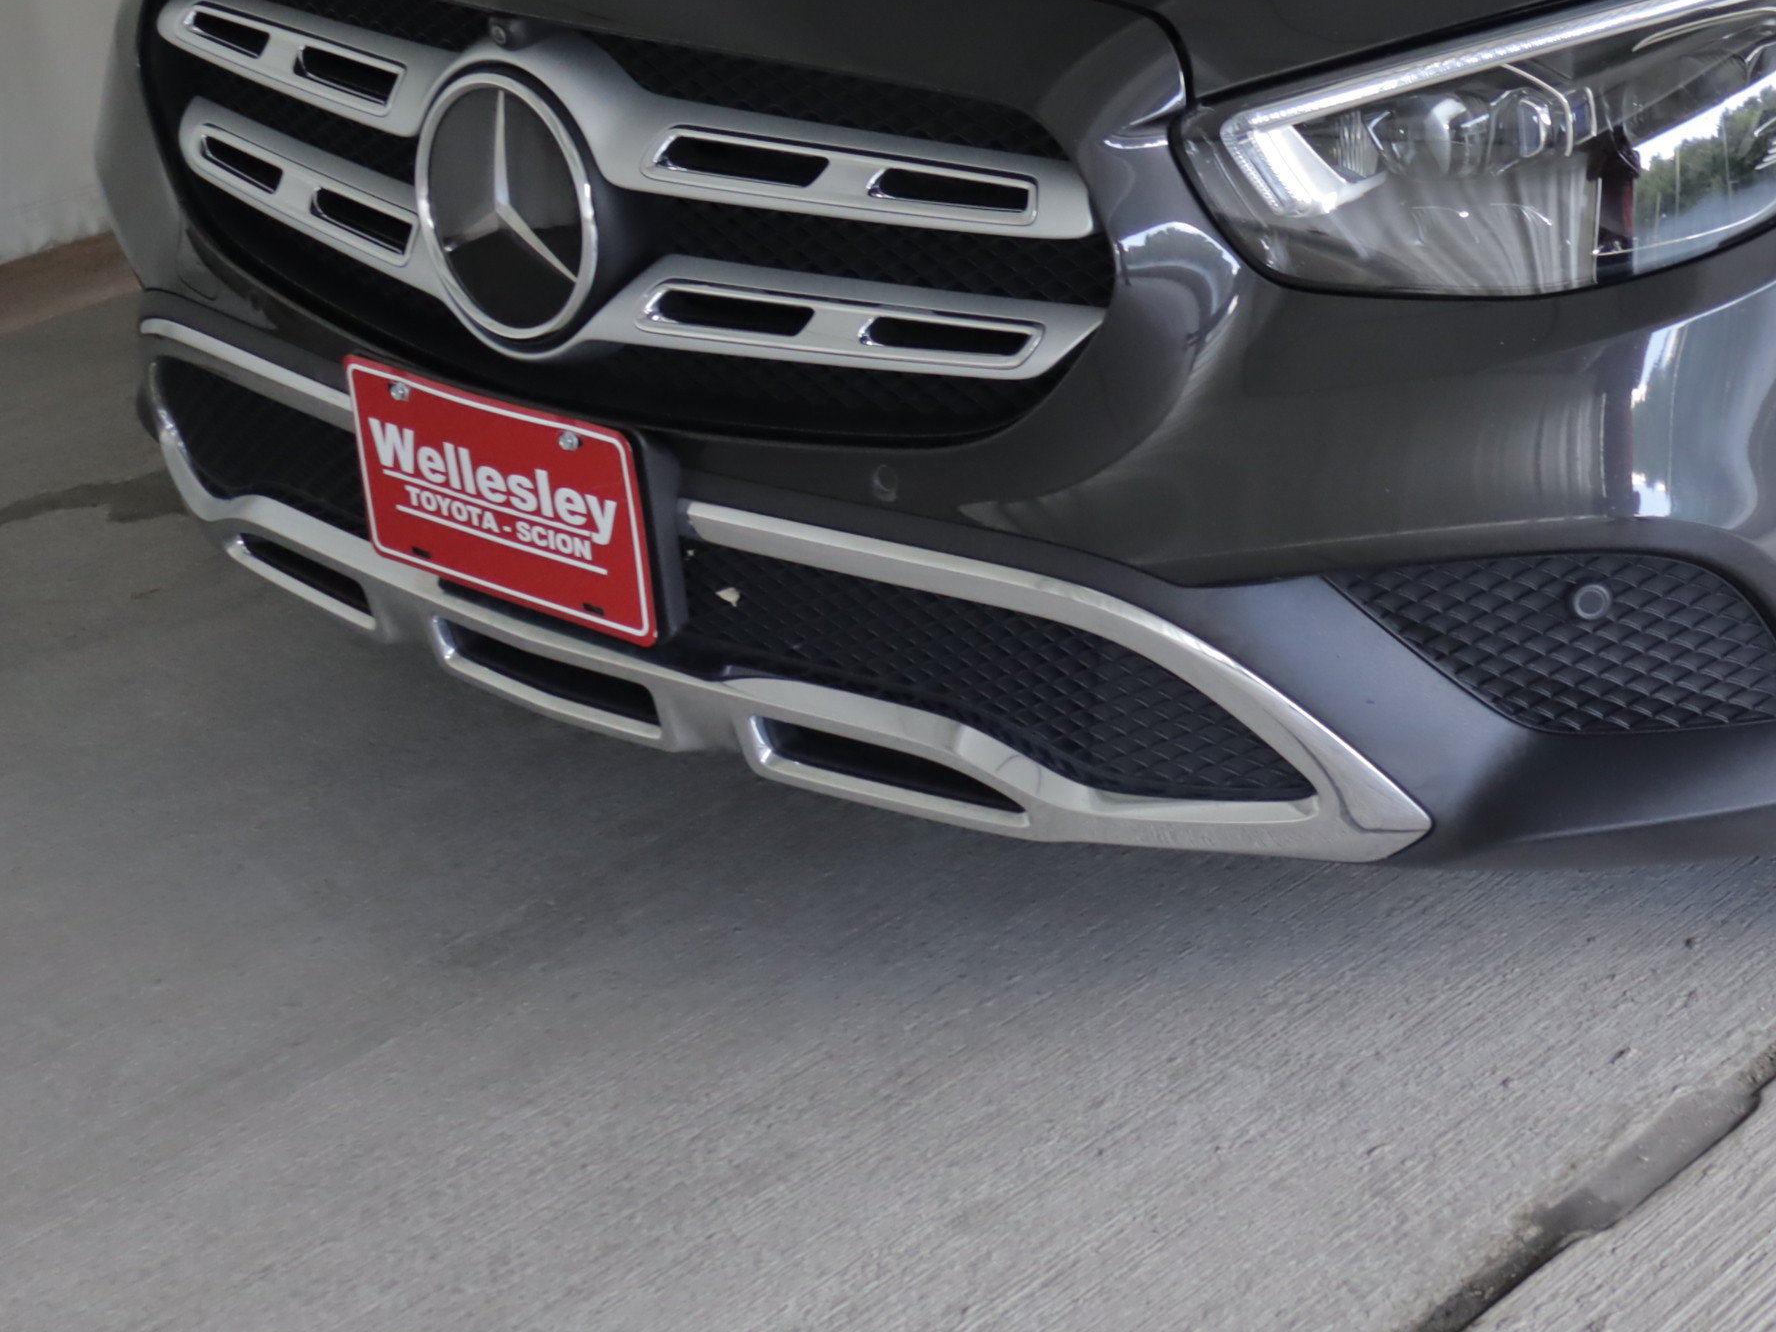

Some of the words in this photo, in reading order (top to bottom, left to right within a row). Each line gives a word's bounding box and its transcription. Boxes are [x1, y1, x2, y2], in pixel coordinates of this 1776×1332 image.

[368, 417, 617, 546] Wellesley
[404, 484, 500, 533] TOYOTA
[515, 520, 593, 560] SCION
